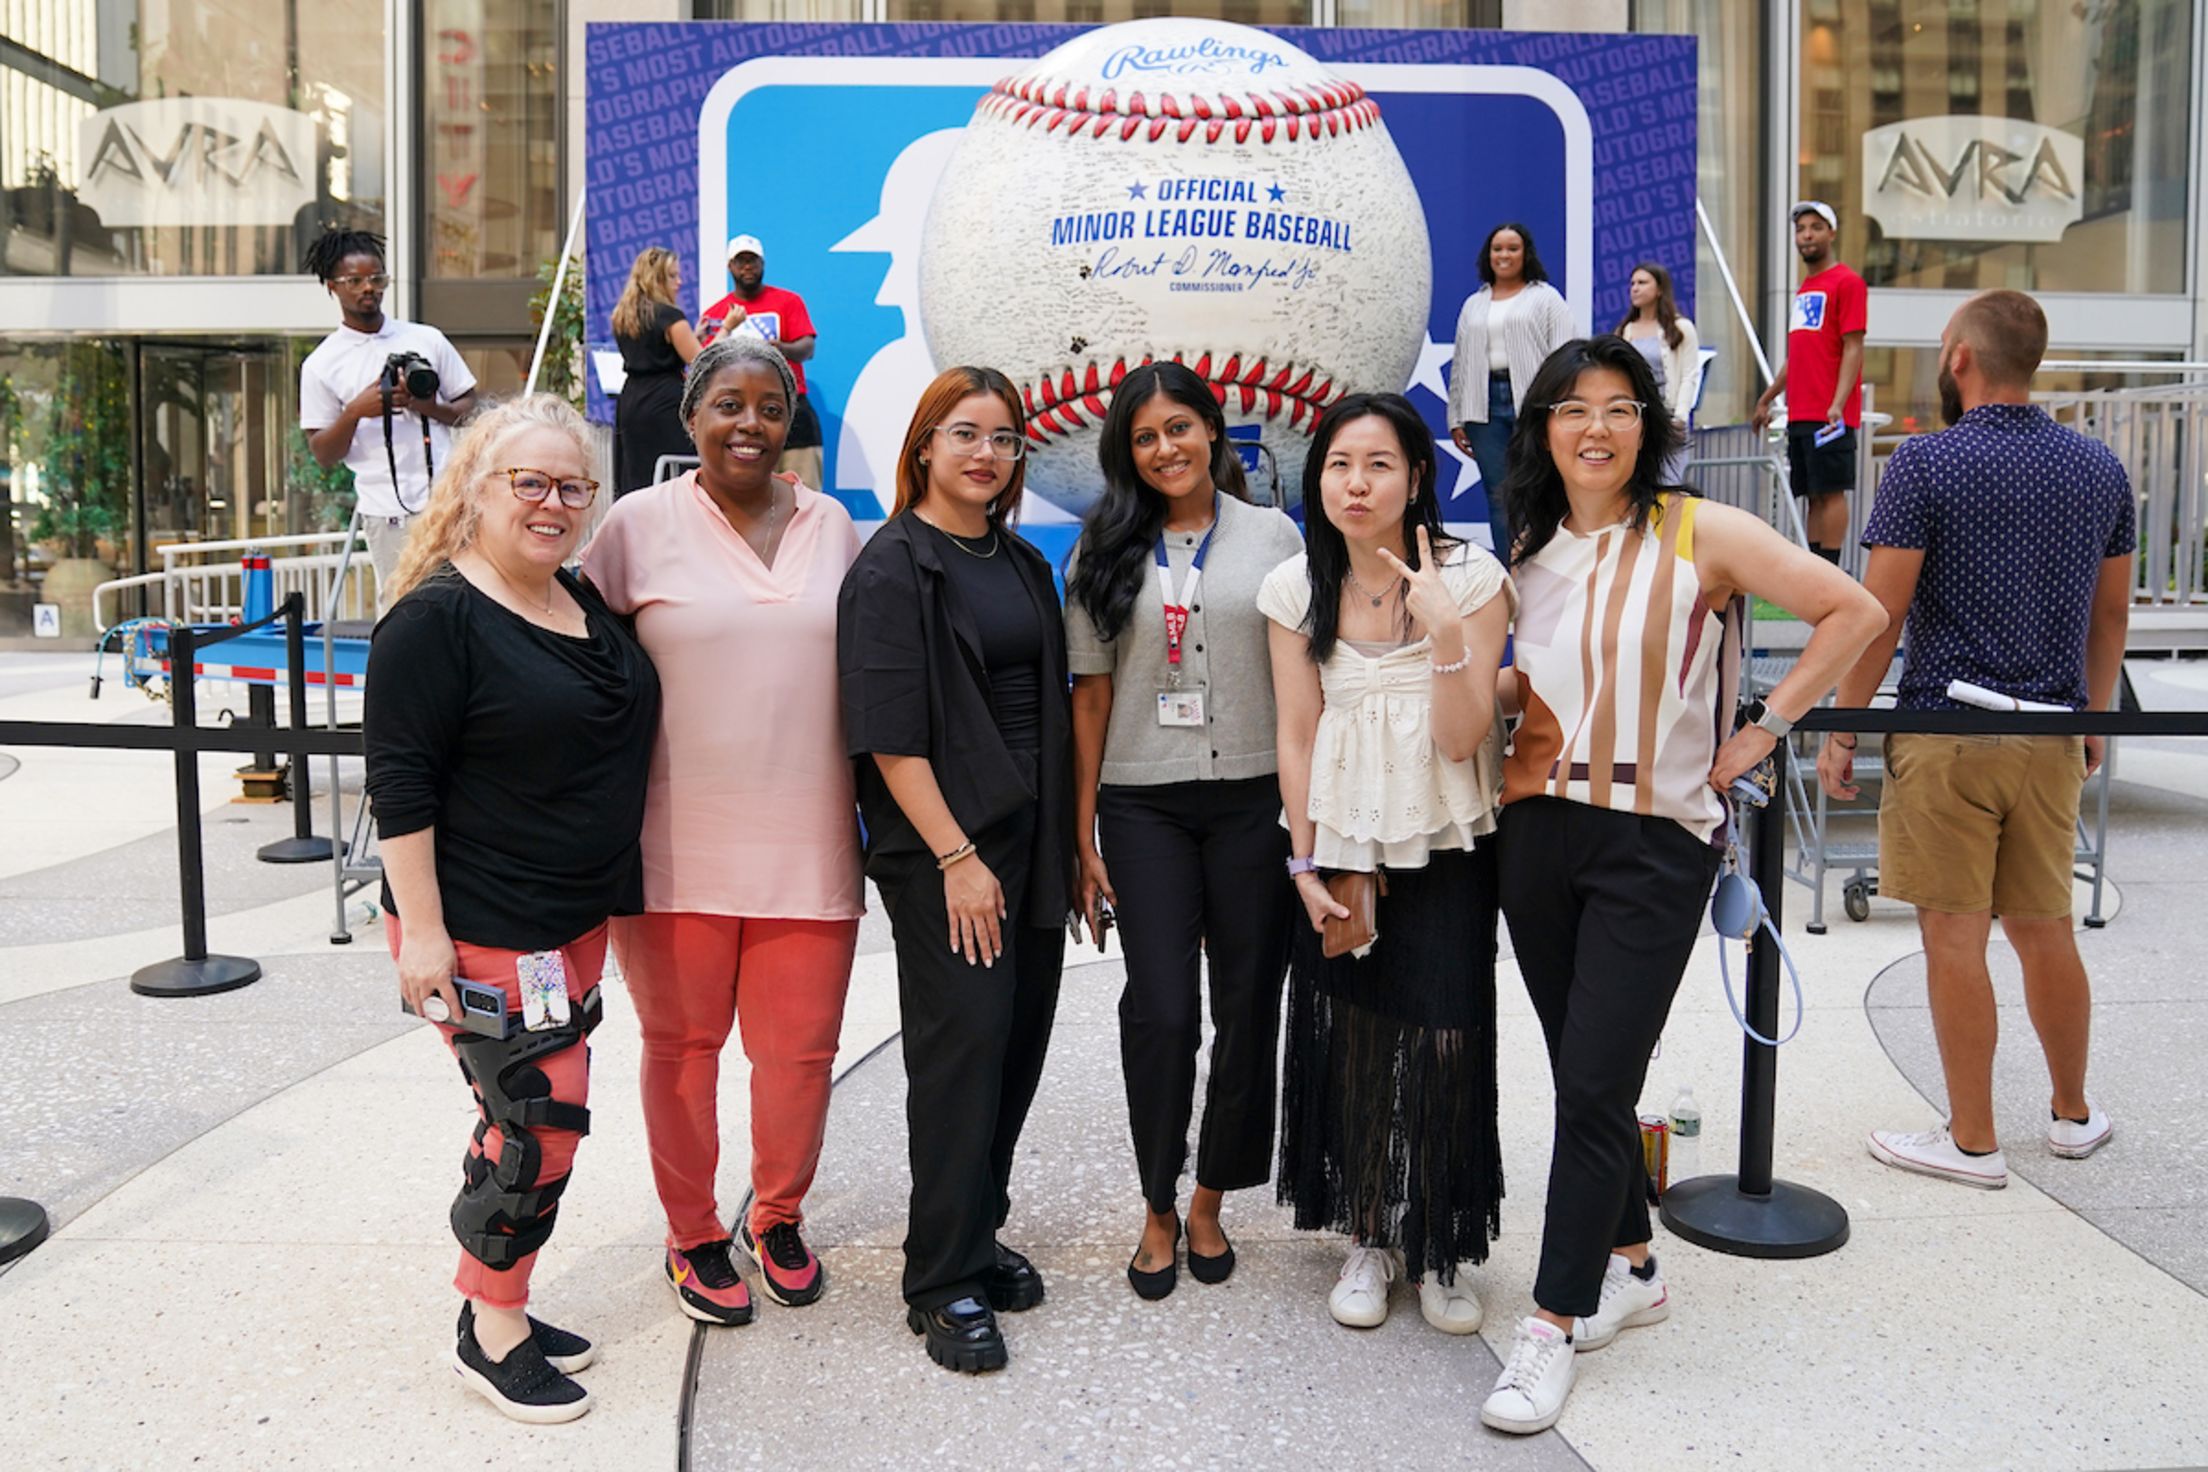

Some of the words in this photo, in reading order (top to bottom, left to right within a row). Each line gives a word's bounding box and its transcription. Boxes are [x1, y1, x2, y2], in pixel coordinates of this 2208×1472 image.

[586, 23, 697, 68] SEBALL
[623, 42, 703, 88] MOST
[1101, 37, 1289, 80] Rawlings
[87, 116, 300, 188] AVRA
[1878, 131, 2076, 204] AVRA
[1158, 179, 1258, 203] OFFICIAL
[1052, 211, 1136, 246] MINOR
[1145, 209, 1237, 238] LEAGUE
[1244, 211, 1352, 253] BASEBALL
[1169, 282, 1244, 293] COMMISSIONER
[40, 609, 55, 627] A
